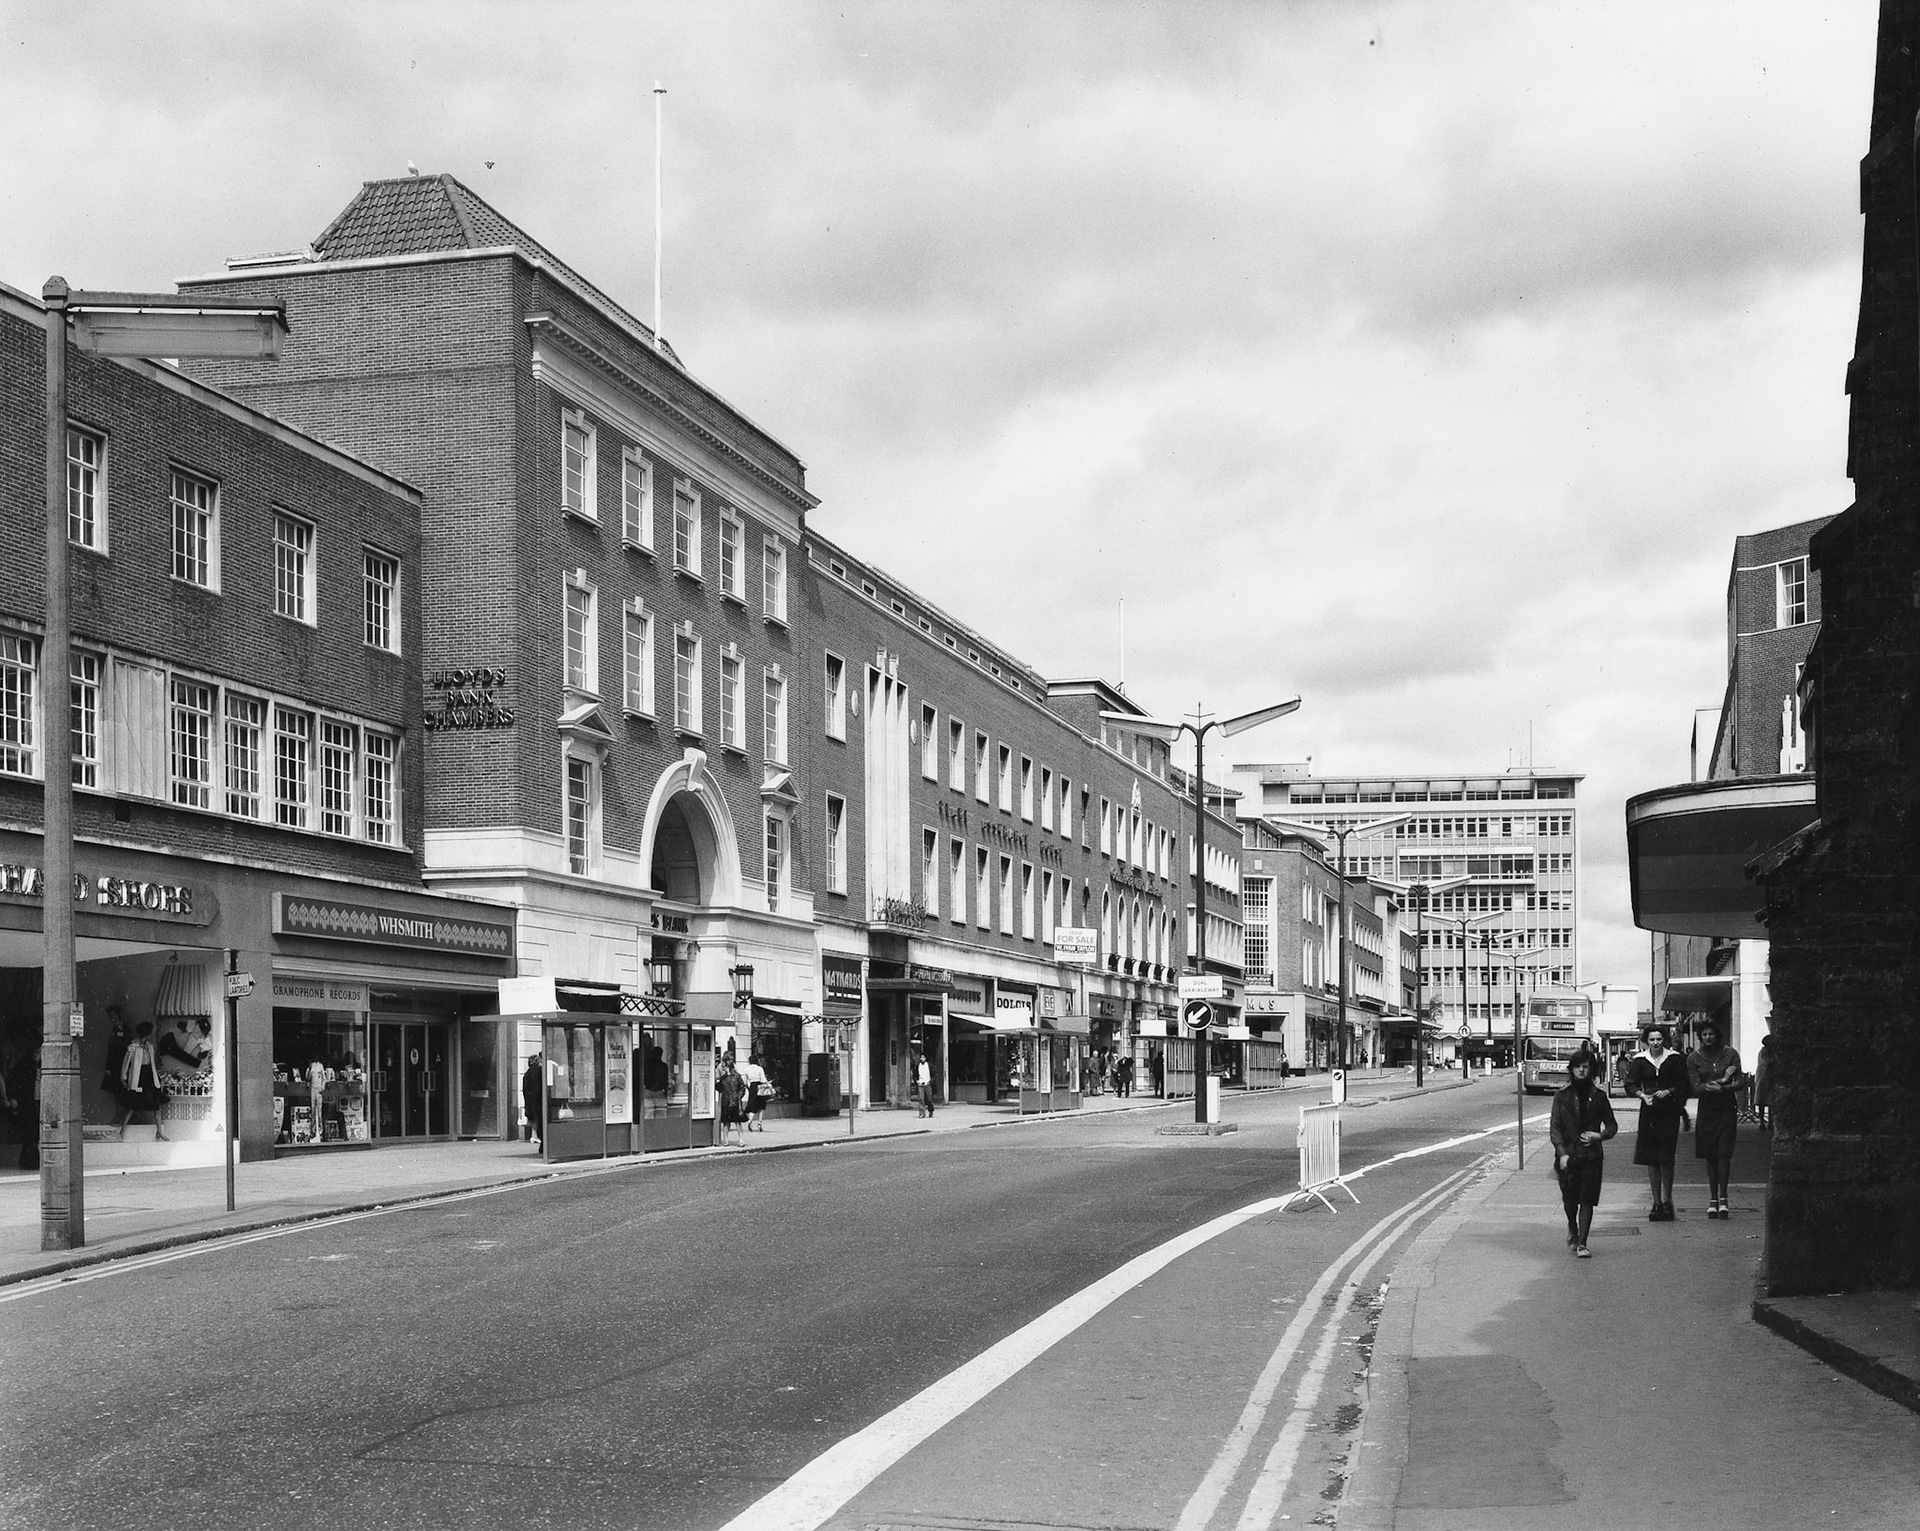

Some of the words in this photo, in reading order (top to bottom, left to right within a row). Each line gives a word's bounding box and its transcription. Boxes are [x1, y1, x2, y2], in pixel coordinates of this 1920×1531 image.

[433, 667, 506, 686] LLOYDS
[446, 689, 494, 706] BANK
[424, 708, 515, 728] CHAMBERS
[98, 877, 193, 914] SHOPS
[378, 915, 434, 940] WHSMITH
[1057, 935, 1074, 943] FOR
[1075, 936, 1094, 944] SALE
[824, 969, 861, 989] MAYNARDS
[273, 985, 325, 999] GRAMOPHONE
[329, 988, 361, 1001] RECORDS
[1246, 998, 1255, 1010] M
[1269, 999, 1275, 1010] S
